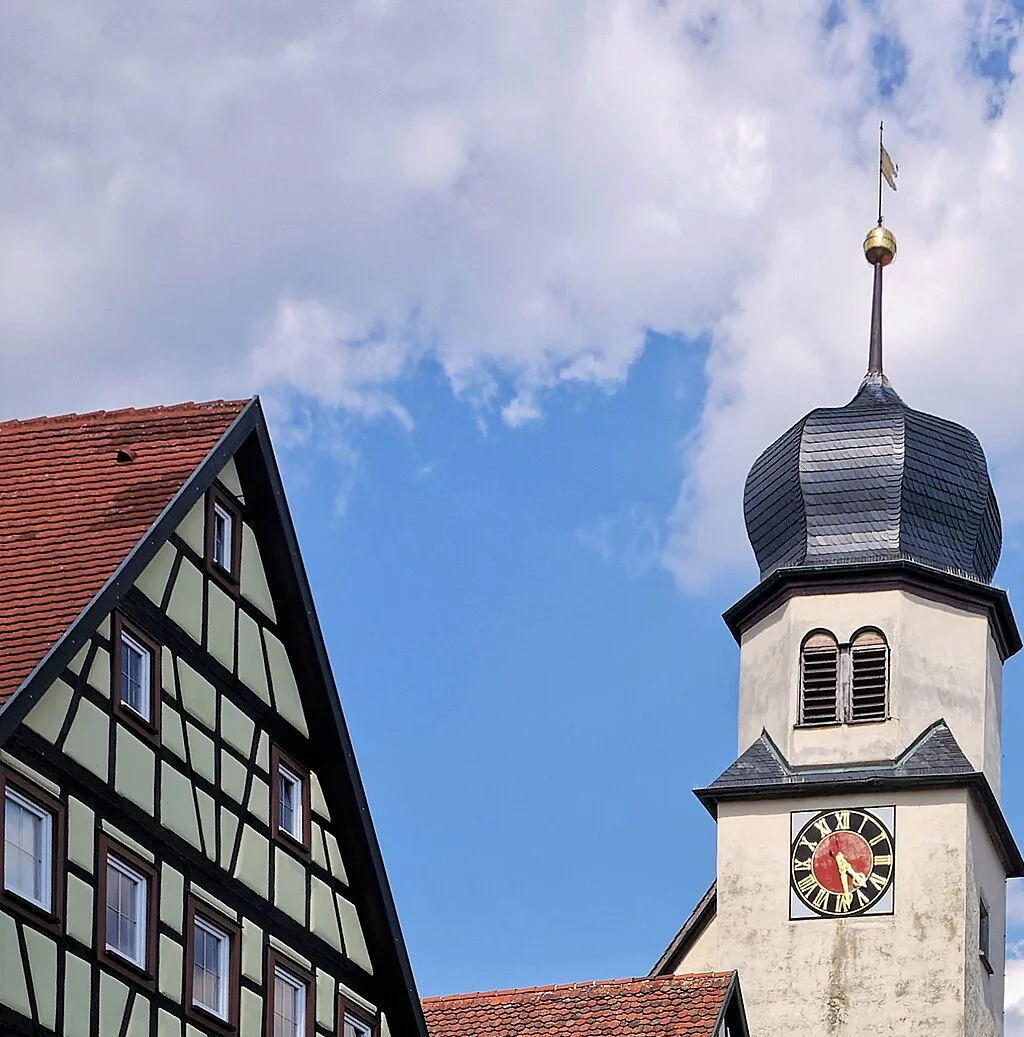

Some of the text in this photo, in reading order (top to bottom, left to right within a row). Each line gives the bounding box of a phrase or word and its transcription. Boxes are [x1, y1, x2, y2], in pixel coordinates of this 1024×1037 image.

[835, 811, 850, 830] XII
[857, 816, 869, 833] I
[799, 836, 818, 852] X
[869, 831, 887, 846] II
[793, 858, 812, 871] IX
[873, 854, 891, 866] III
